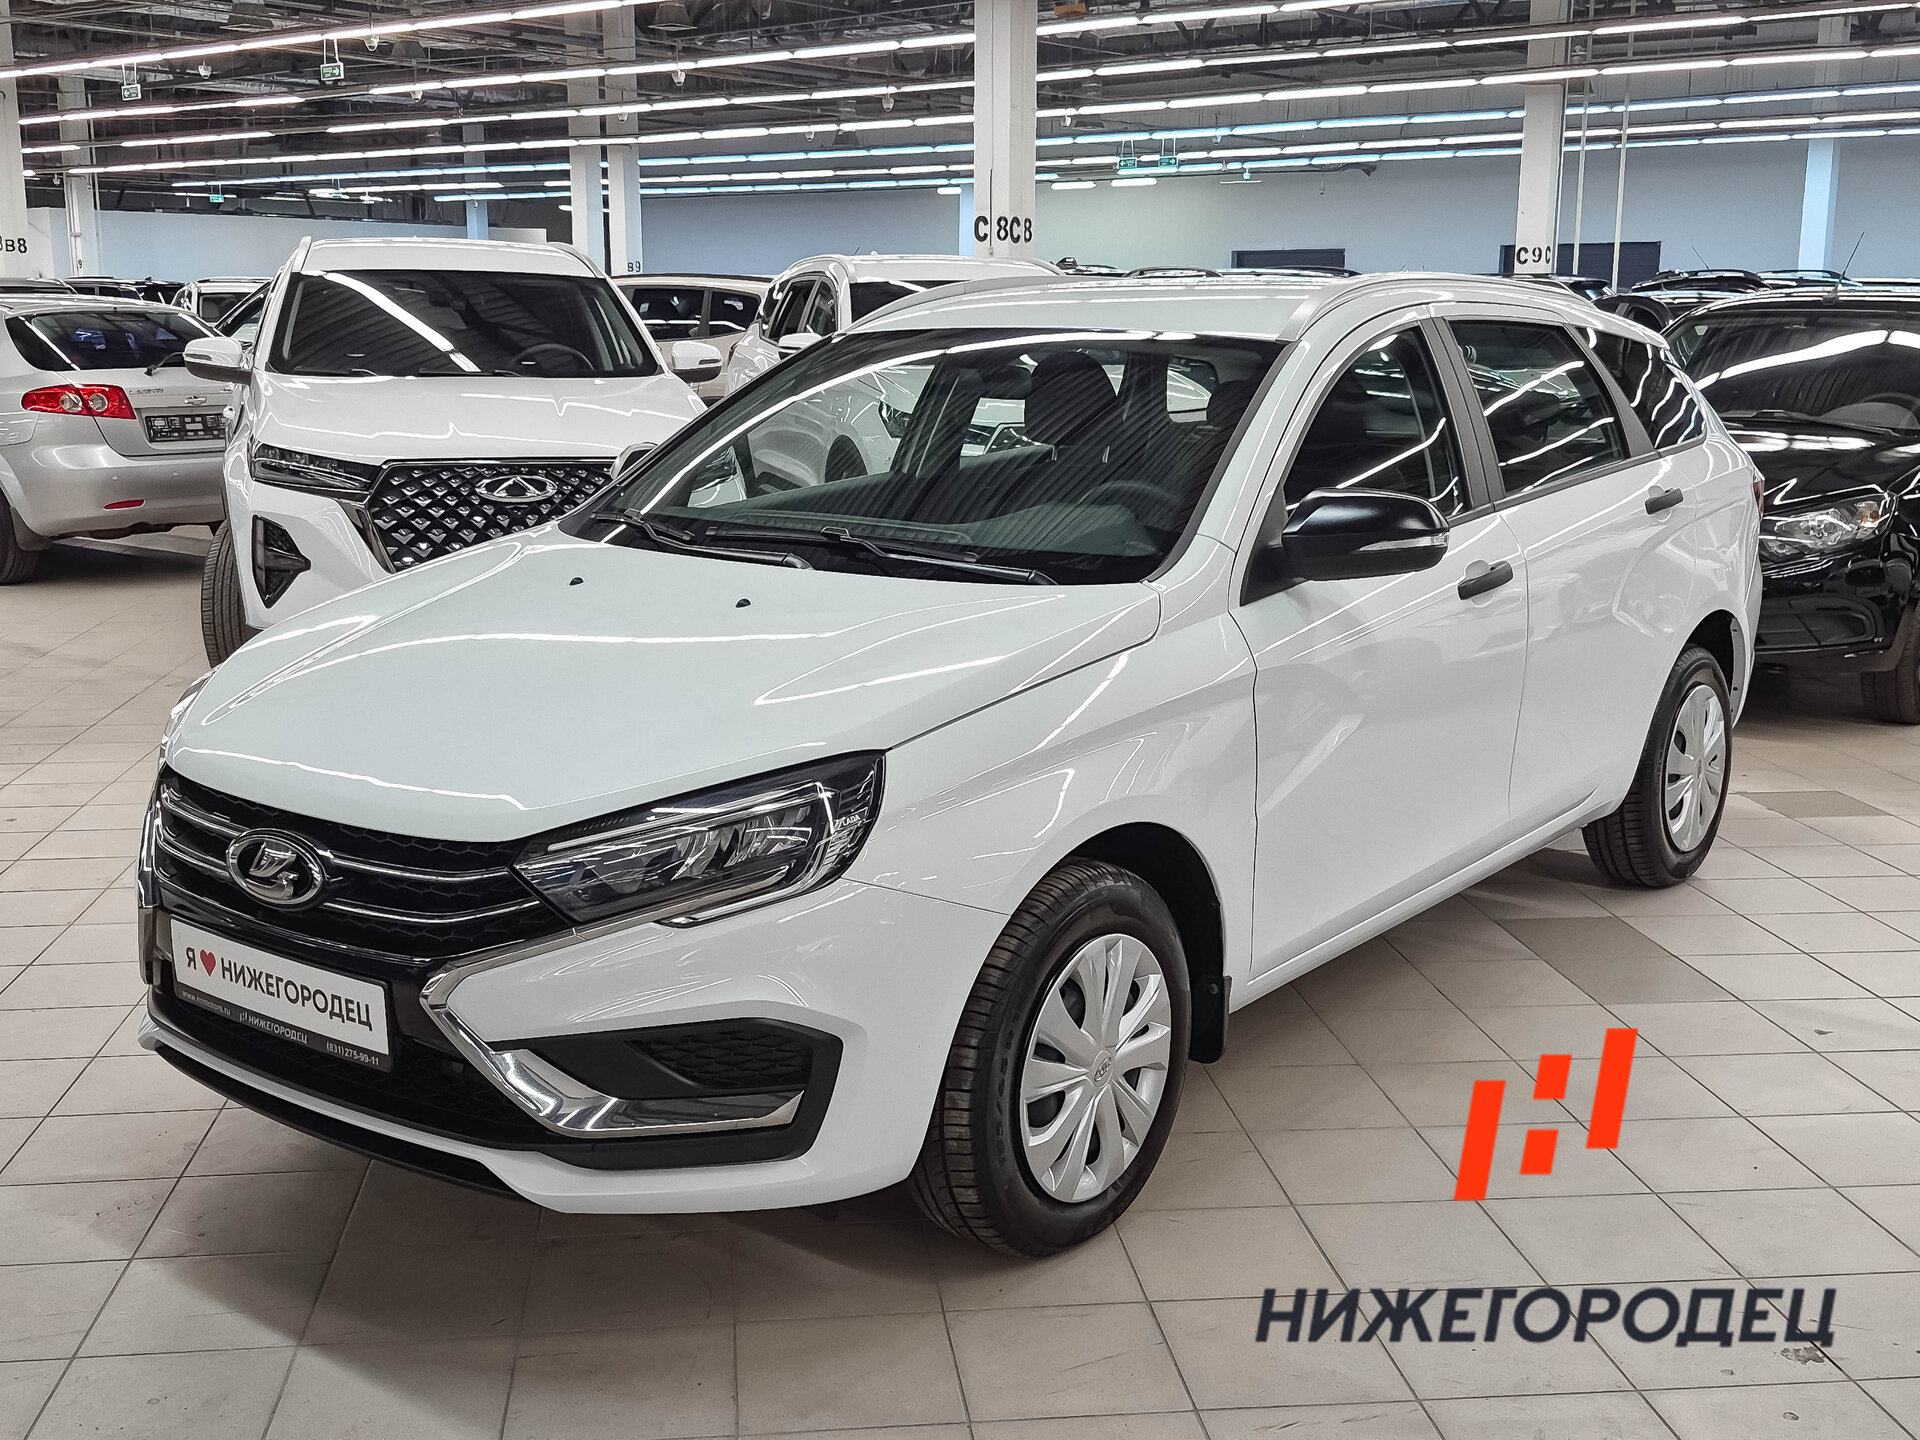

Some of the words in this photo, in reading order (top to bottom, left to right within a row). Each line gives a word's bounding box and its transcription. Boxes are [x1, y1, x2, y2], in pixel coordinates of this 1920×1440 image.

[627, 260, 641, 273] B9
[185, 946, 197, 971] Я
[221, 957, 373, 1032] НИЖЕГОРОДЕЦ
[248, 1014, 308, 1045] НИЖЕГОРОДЕЦ
